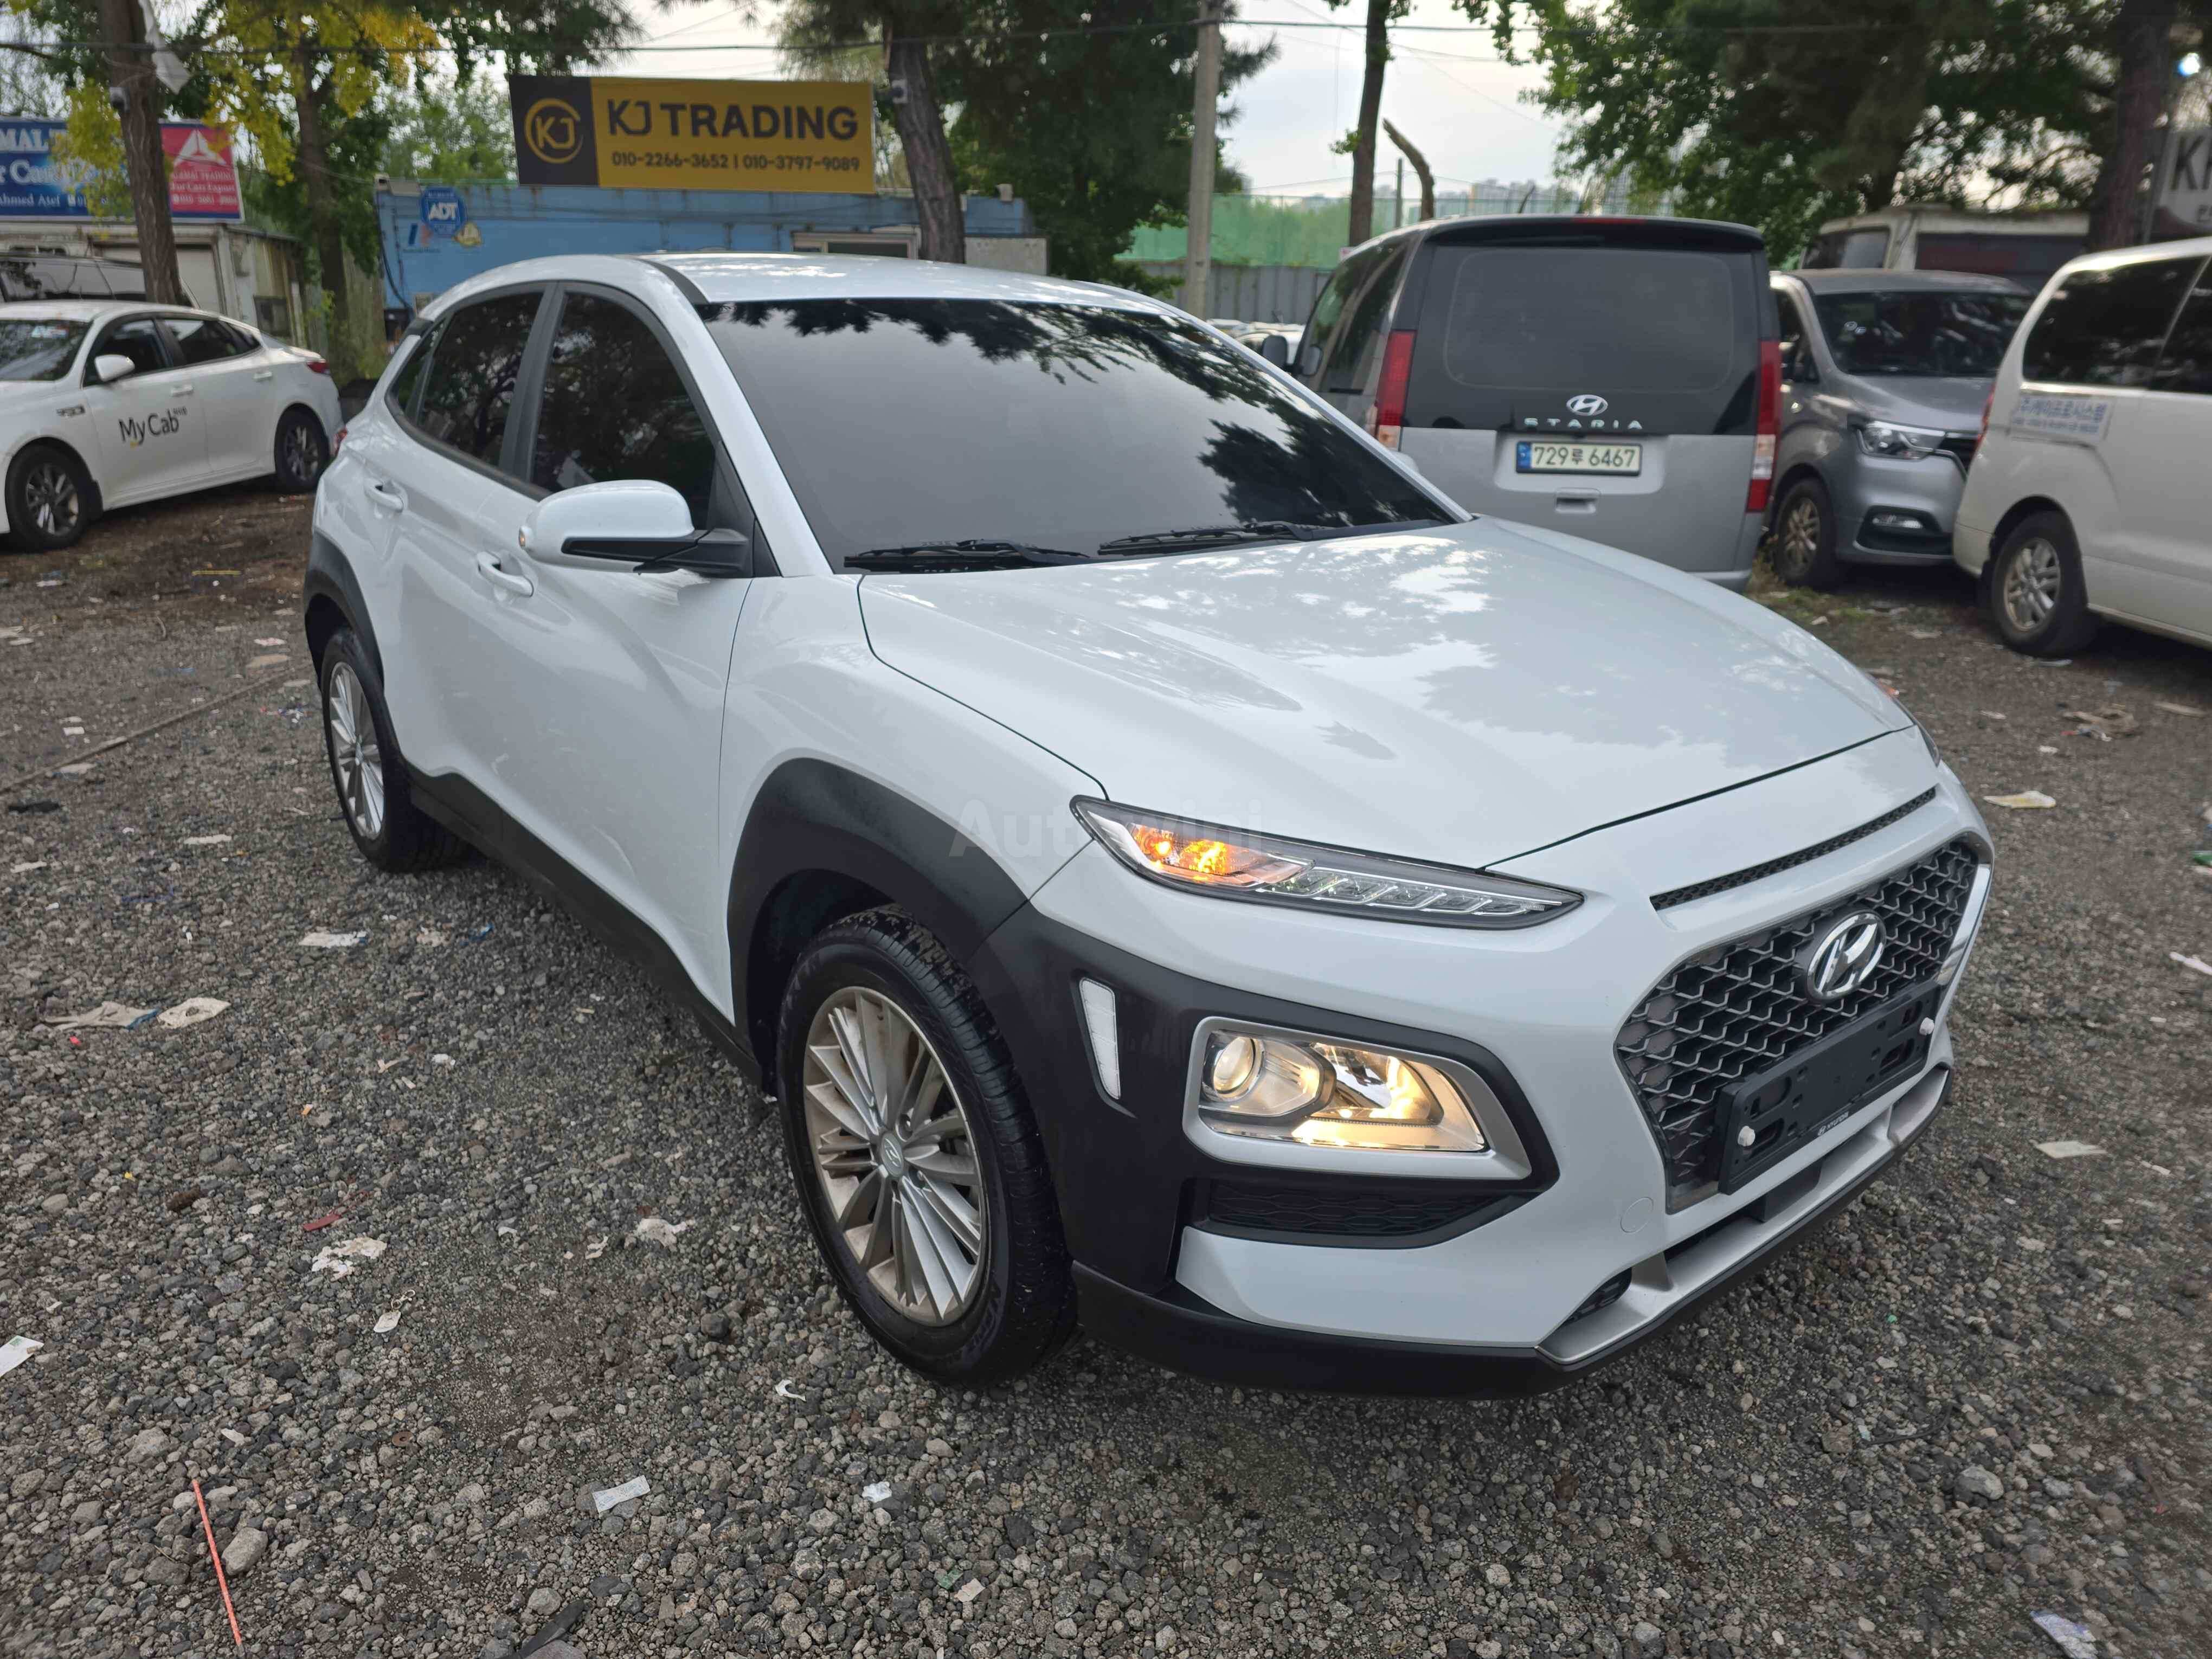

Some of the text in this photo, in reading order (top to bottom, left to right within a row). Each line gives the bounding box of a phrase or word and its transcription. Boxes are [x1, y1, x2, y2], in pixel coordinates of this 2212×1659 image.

[607, 99, 859, 140] KJ TRADING
[612, 151, 860, 172] 010-2266-3652 010-3797-9089
[428, 201, 457, 220] ADT
[1523, 417, 1643, 430] STARIA
[1589, 448, 1636, 467] 6467
